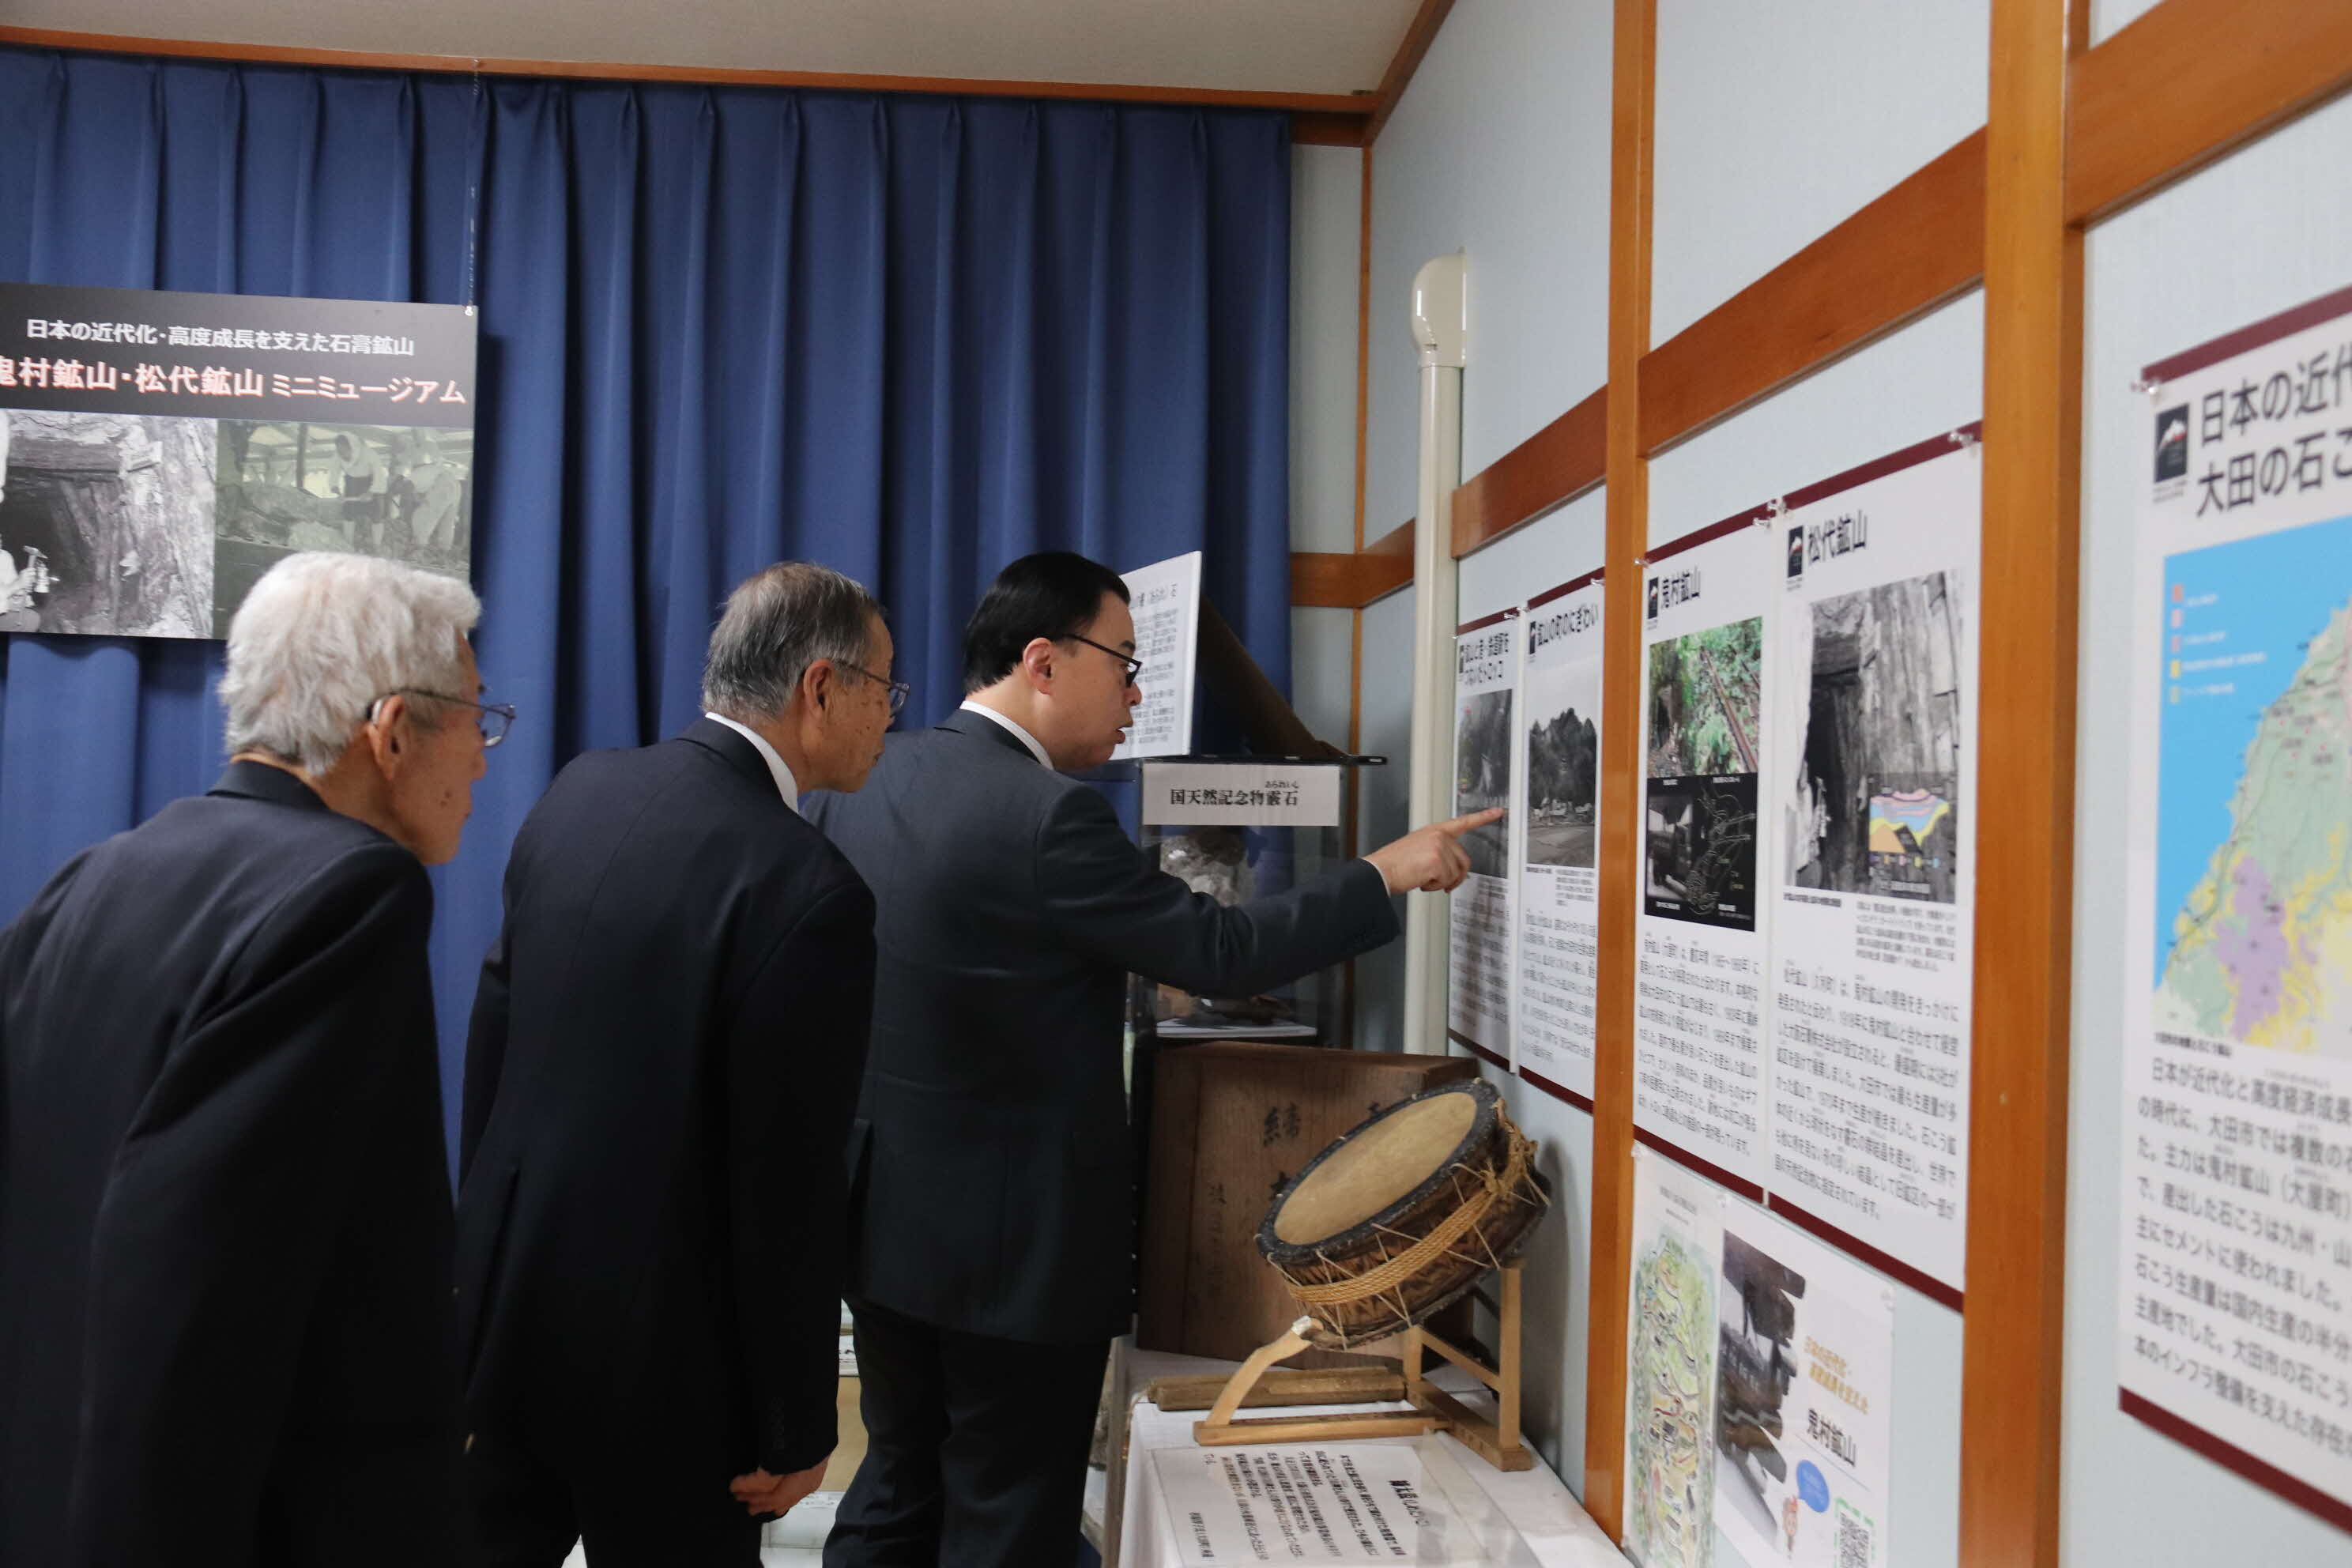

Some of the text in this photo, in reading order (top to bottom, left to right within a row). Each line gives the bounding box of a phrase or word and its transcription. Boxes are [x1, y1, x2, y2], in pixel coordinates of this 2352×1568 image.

[26, 318, 416, 357] 日本の近代化・高度成長を支えた石膏鉱山
[272, 373, 467, 405] ミニミュージアム
[1807, 508, 1868, 567] 松代鉱山
